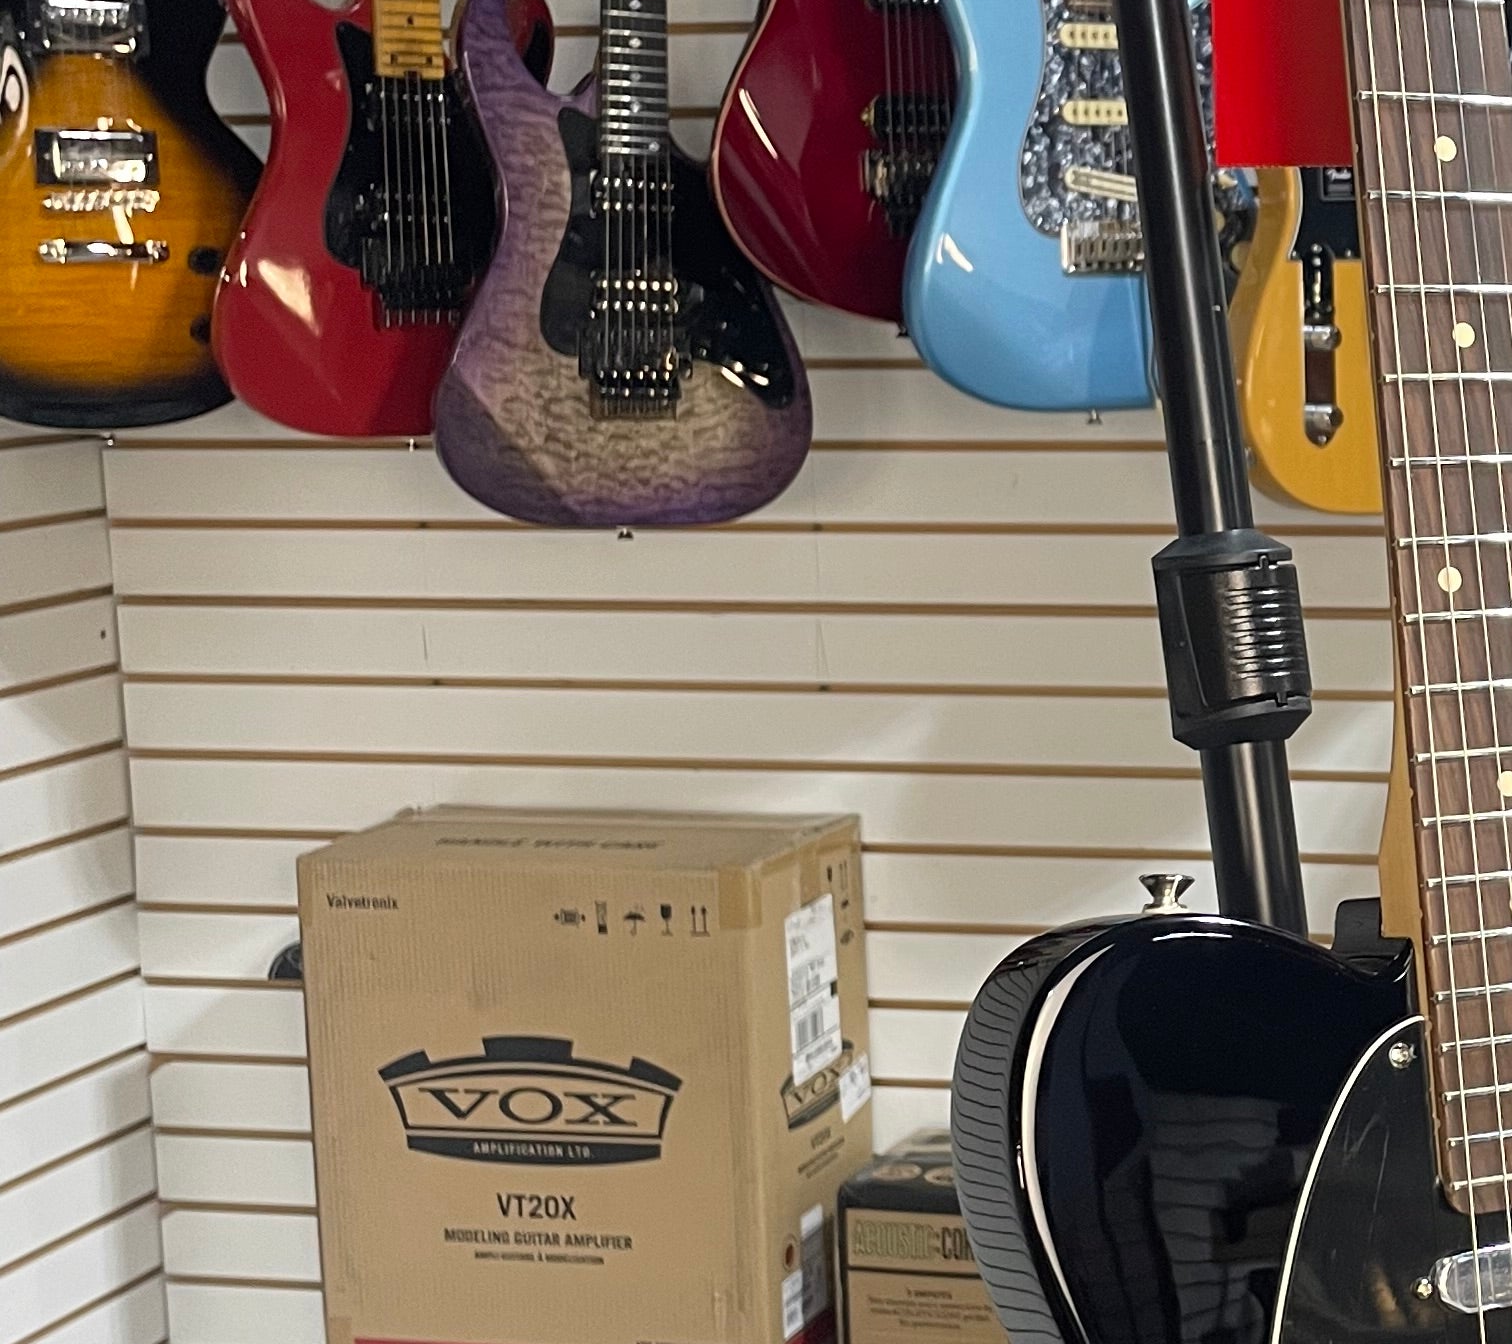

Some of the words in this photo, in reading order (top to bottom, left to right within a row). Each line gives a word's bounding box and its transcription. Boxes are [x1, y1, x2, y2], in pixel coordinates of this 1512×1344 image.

[419, 1087, 638, 1127] VOX
[473, 1142, 564, 1158] AMPLIFICATION
[496, 1192, 577, 1221] VT20X
[444, 1227, 510, 1245] MODELING
[514, 1230, 561, 1247] GUITAR
[564, 1234, 633, 1251] AMPLIFIER
